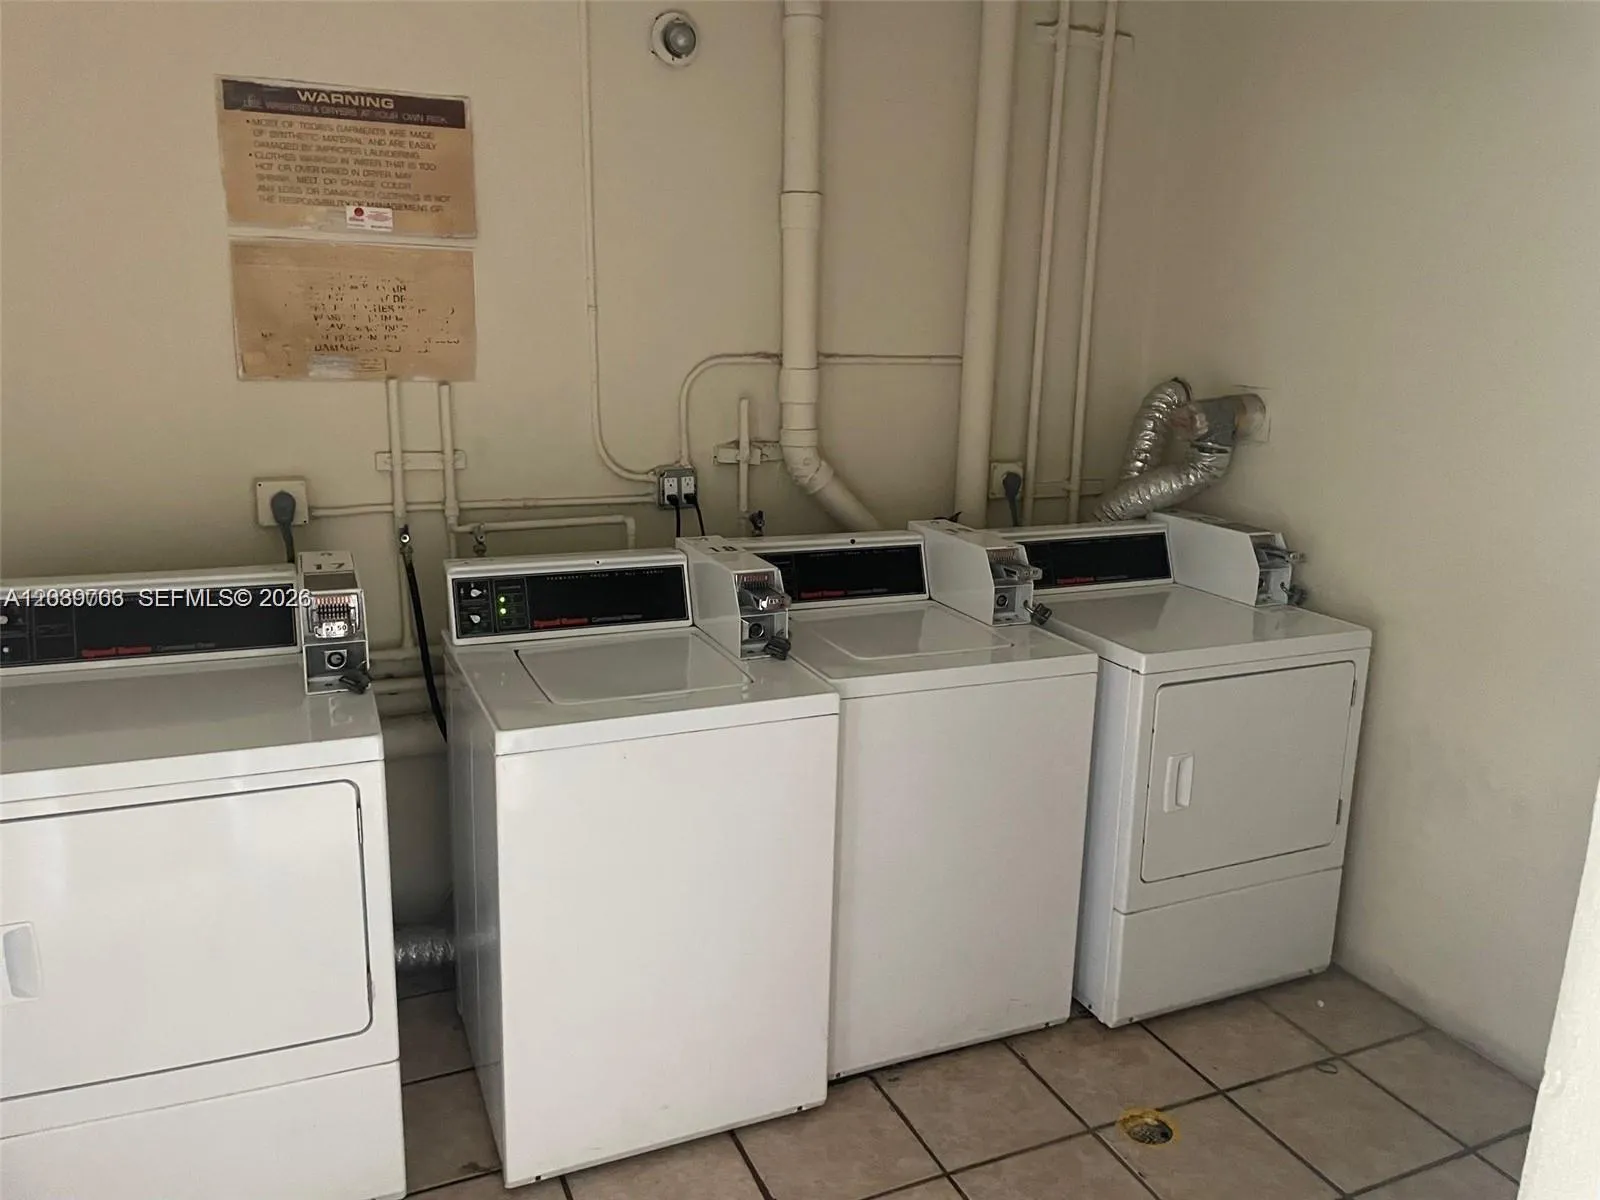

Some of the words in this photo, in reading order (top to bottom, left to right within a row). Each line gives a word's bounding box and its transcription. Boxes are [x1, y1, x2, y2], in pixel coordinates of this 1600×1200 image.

[296, 89, 395, 109] WARNING
[373, 109, 398, 119] YOUR
[402, 112, 425, 121] OWN
[252, 119, 278, 128] MOST
[281, 120, 293, 128] OF
[389, 129, 407, 137] ARE
[409, 130, 434, 139] MADE
[253, 129, 264, 137] OF
[269, 130, 321, 141] SYNTHETIC
[367, 138, 387, 146] AND
[388, 139, 407, 148] ARE
[408, 140, 437, 150] EASILY
[253, 140, 298, 151] DAMAGED
[255, 152, 296, 162] CLOTHES
[340, 157, 350, 165] IN
[385, 160, 405, 169] THAT
[407, 161, 417, 169] IS
[418, 162, 437, 171] TOO
[255, 163, 273, 171] HOT
[278, 164, 292, 172] OR
[294, 165, 320, 174] OVER
[350, 168, 360, 176] IN
[362, 169, 392, 178] DRYER
[394, 171, 413, 179] MAY
[296, 176, 318, 184] MELT
[340, 179, 376, 188] CHANGE
[258, 195, 275, 203] THE
[278, 195, 350, 208] RESPONSIBILITY
[278, 185, 303, 193] LOSS
[306, 187, 320, 195] OR
[323, 188, 364, 197] DAMAGE
[377, 191, 421, 201] CLOTHING
[423, 194, 433, 202] IS
[434, 195, 452, 203] NOT
